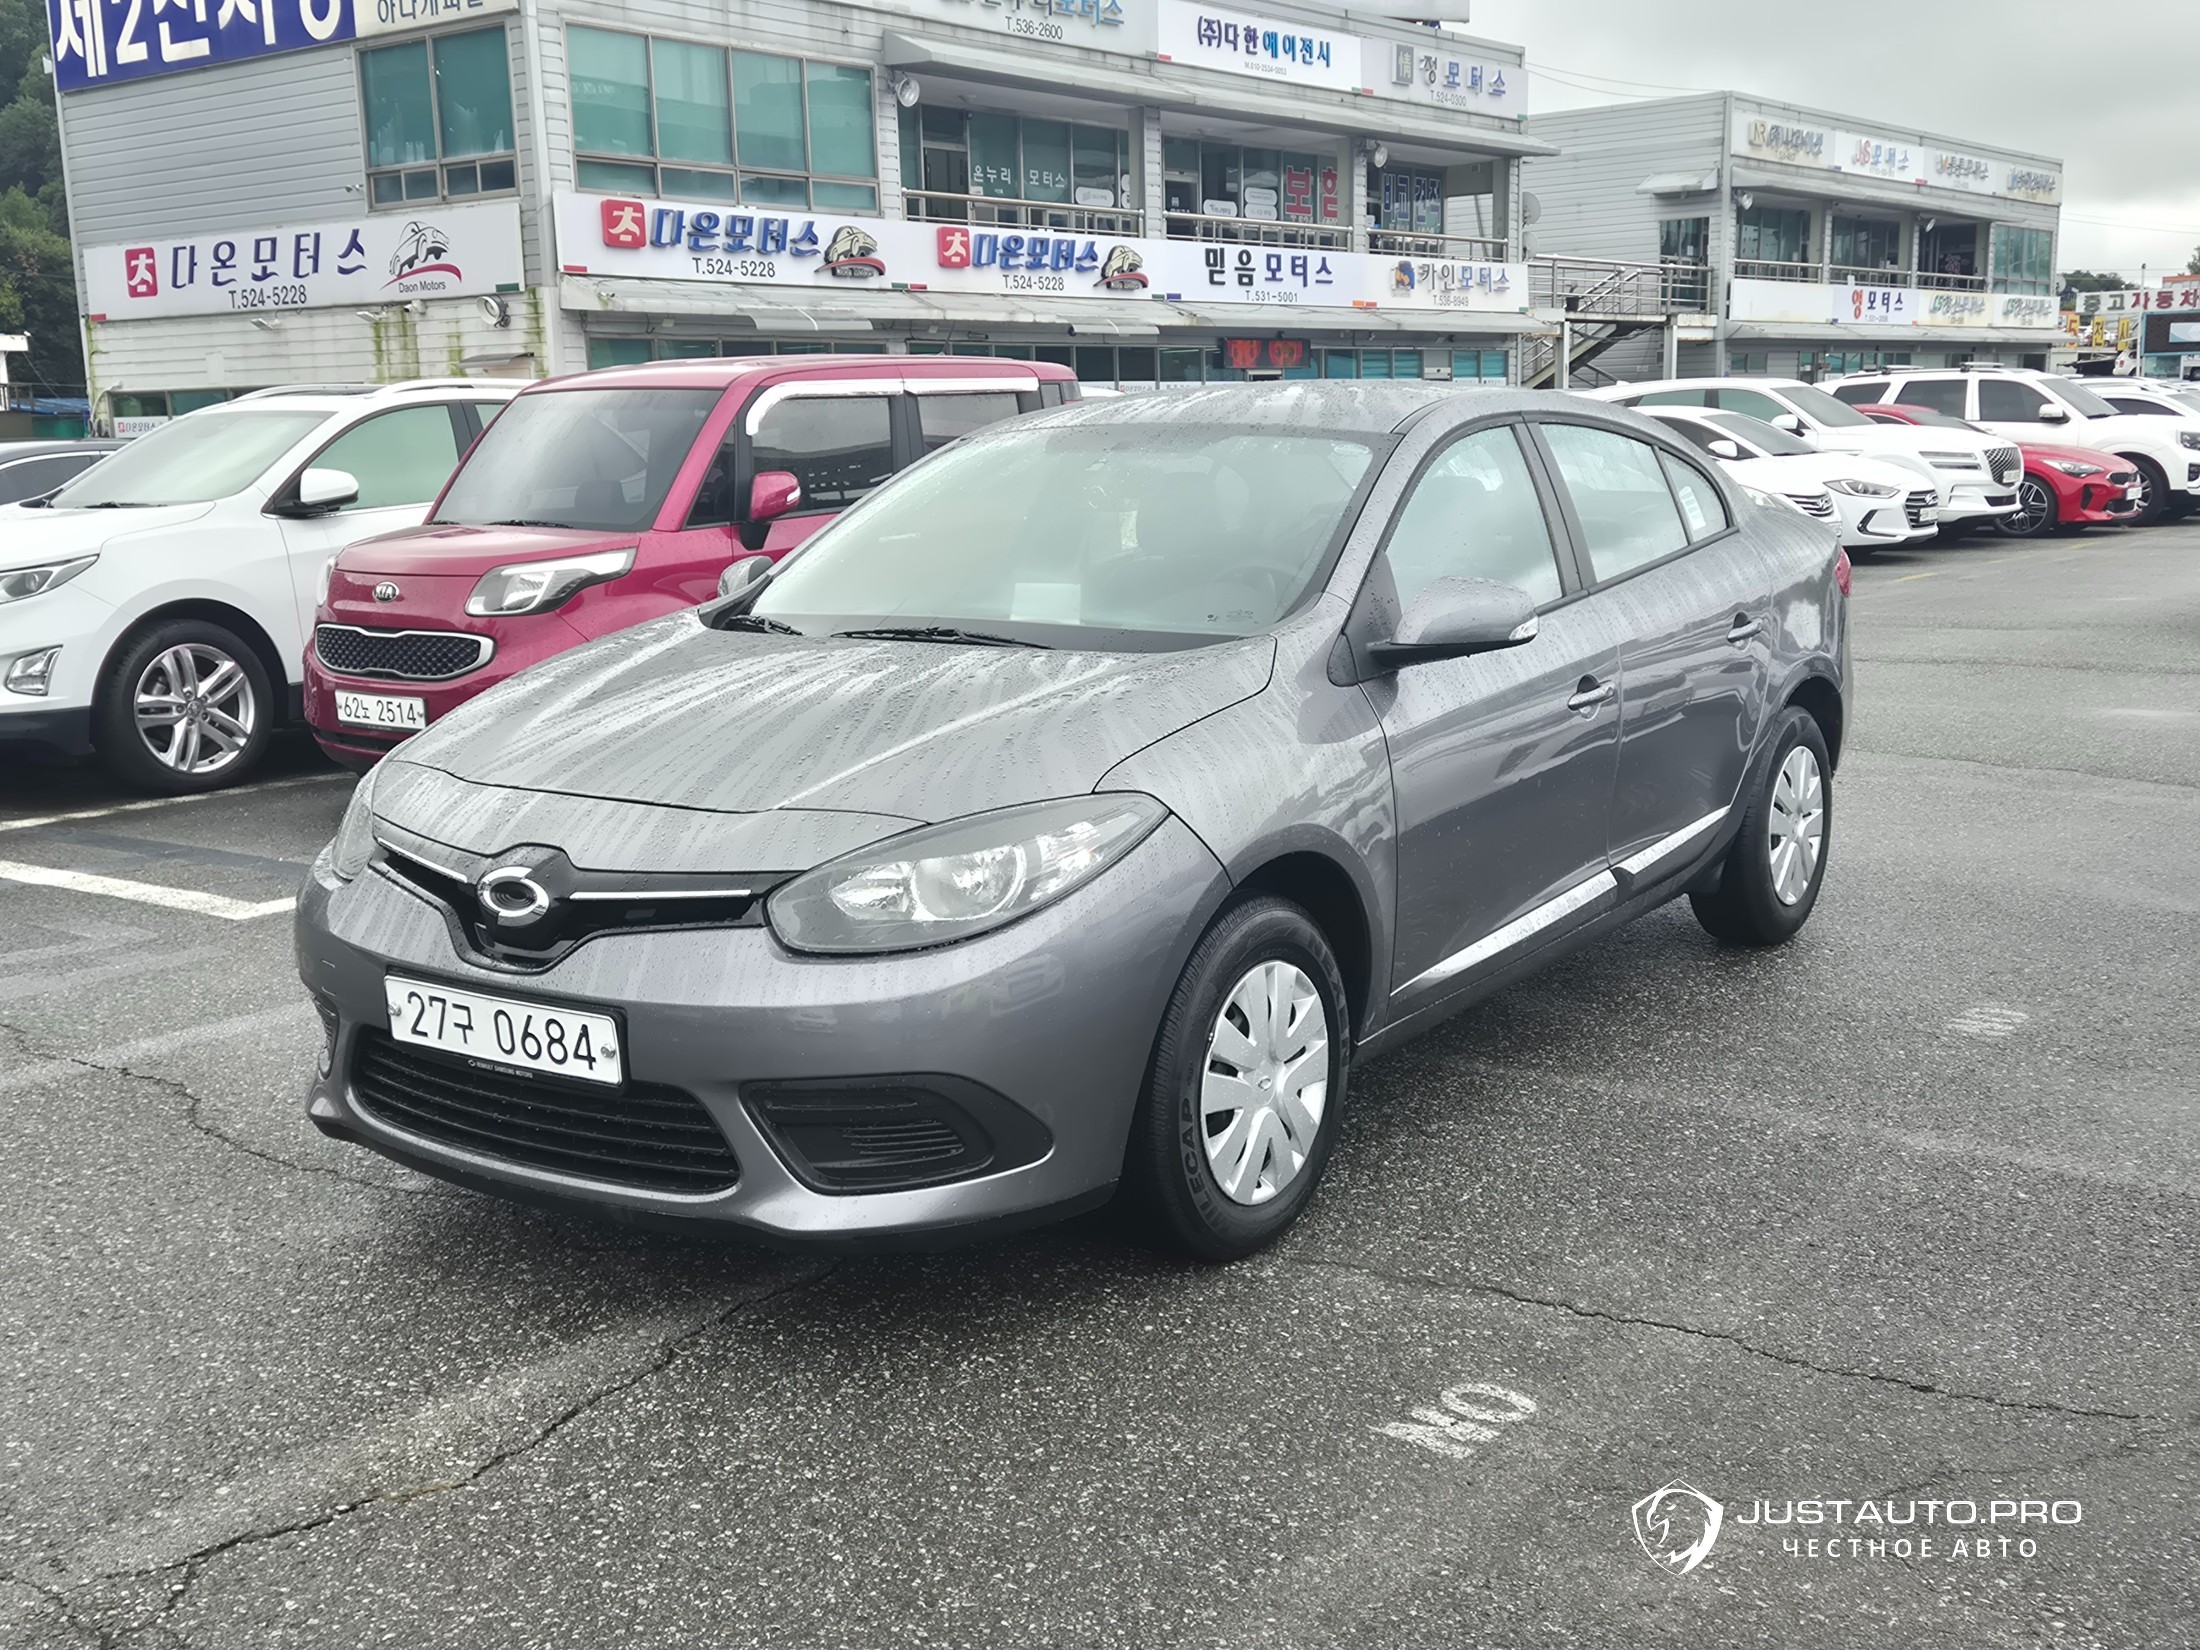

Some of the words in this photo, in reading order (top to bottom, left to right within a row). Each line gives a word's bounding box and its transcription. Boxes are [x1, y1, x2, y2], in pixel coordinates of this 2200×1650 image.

[1005, 15, 1063, 40] T.536-2600
[1420, 54, 1506, 94] 정모터스
[973, 164, 1011, 185] 온누리
[1029, 169, 1067, 188] 모터스
[650, 207, 822, 257] 다온모터스
[171, 228, 368, 289] 다온모터스
[971, 233, 1099, 273] 다온모터스
[692, 257, 776, 278] T.524-5228
[1205, 247, 1333, 288] 믿음모터스
[1420, 263, 1511, 293] 카인모터스
[398, 283, 418, 294] Daon
[420, 280, 447, 291] Motors
[1002, 274, 1065, 291] T.524-5228
[228, 284, 307, 309] T.524-5228
[1245, 290, 1299, 303] T.531-5001
[375, 585, 396, 599] KIA
[344, 696, 370, 720] 62노
[376, 699, 417, 725] 2514
[407, 991, 474, 1044] 27구
[493, 1009, 597, 1071] 0684
